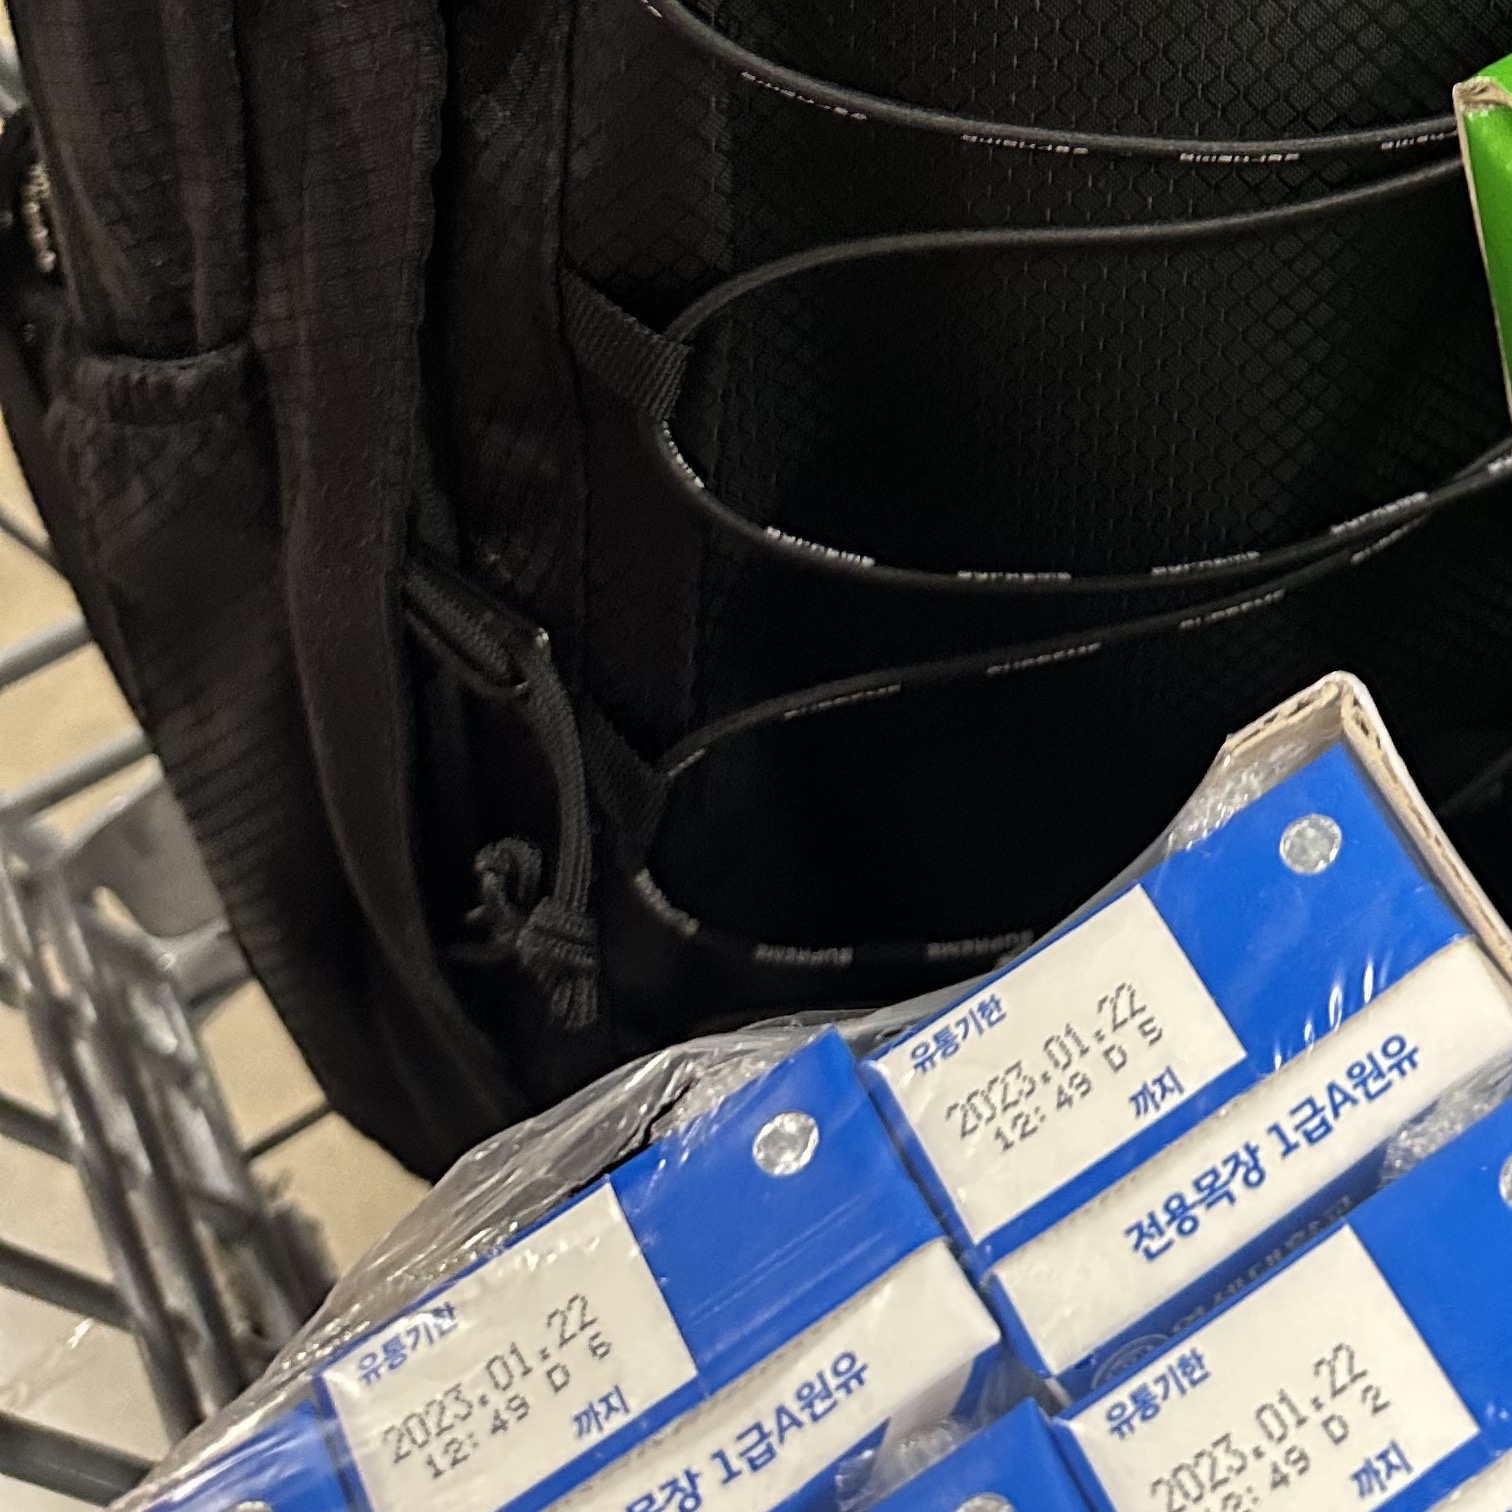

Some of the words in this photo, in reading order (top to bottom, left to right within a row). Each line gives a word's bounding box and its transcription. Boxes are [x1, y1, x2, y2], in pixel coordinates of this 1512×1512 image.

[910, 993, 1007, 1074] 유통기한
[945, 982, 1148, 1140] 2023.01.22
[1103, 1044, 1128, 1074] D
[1129, 1066, 1185, 1120] 까지
[1123, 1139, 1268, 1264] 전용목장
[1267, 1032, 1421, 1161] 1급A원유
[381, 1292, 600, 1465] 2023.01.22
[546, 1362, 571, 1394] D
[571, 1384, 630, 1439] 까지
[711, 1350, 870, 1486] 1급A원유
[1106, 1346, 1212, 1440] 유통기한
[1321, 1413, 1350, 1446] D
[1361, 1383, 1391, 1417] 2
[1150, 1342, 1369, 1512] 2023.01.22
[1349, 1438, 1415, 1500] 까지
